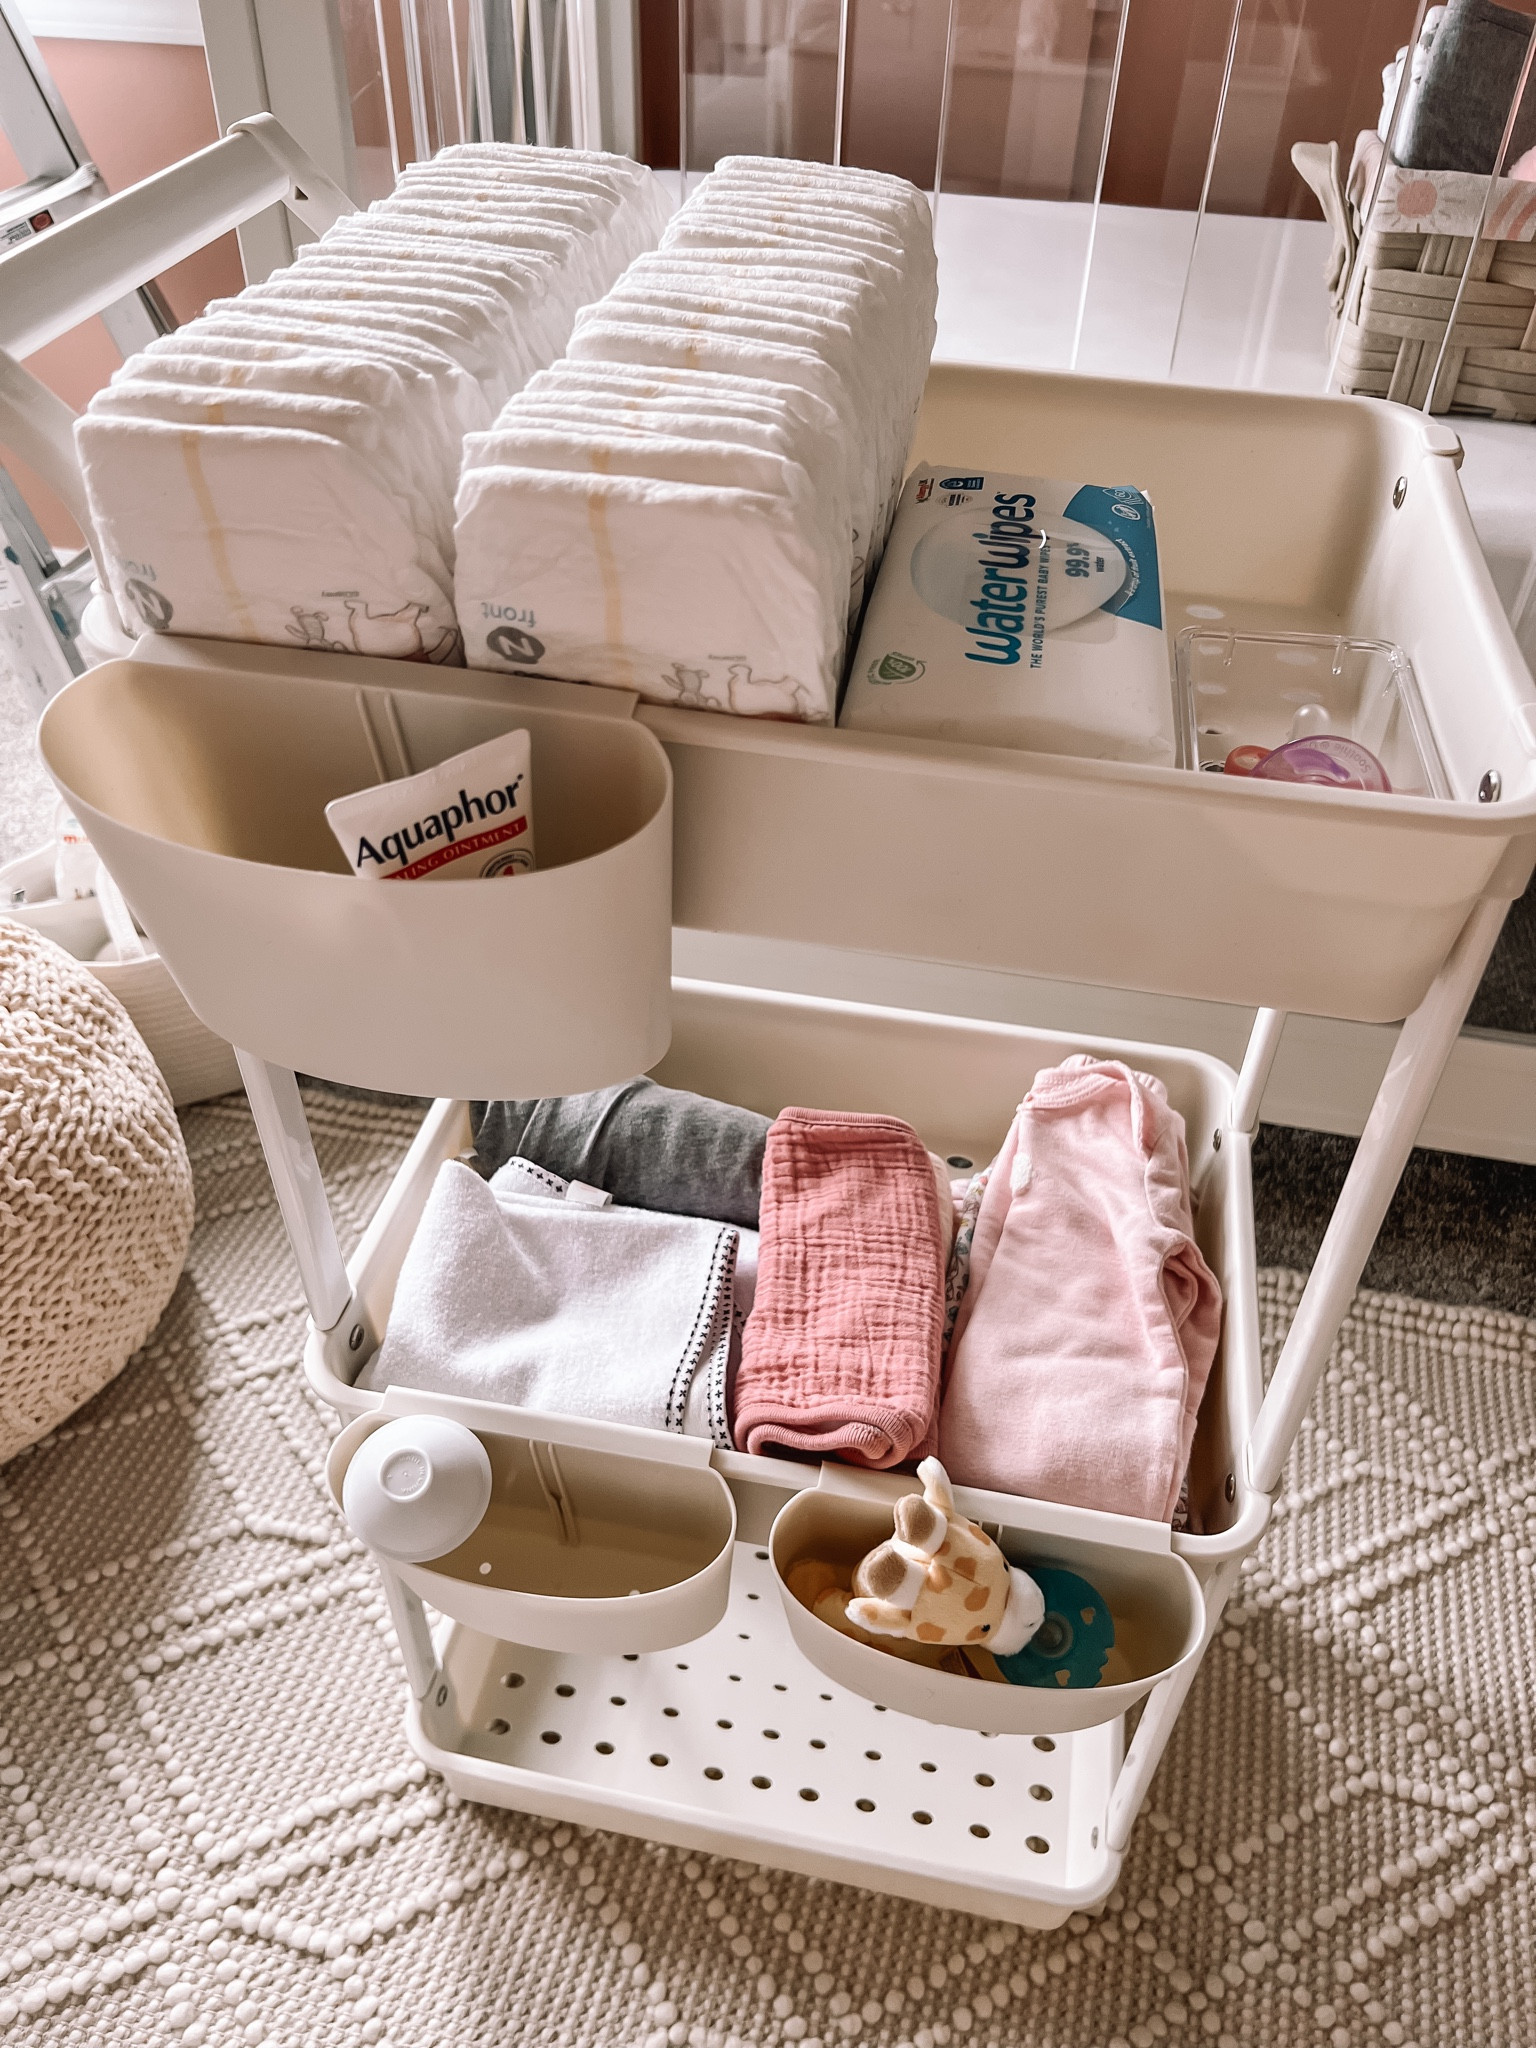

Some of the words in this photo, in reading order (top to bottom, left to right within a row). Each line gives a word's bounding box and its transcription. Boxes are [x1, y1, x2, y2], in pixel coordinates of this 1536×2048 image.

[1040, 544, 1051, 563] WIPES
[1094, 556, 1105, 572] water
[965, 493, 1050, 665] WaterWipes
[1038, 565, 1049, 584] BABY
[1035, 586, 1048, 614] PUREST
[481, 602, 536, 628] front
[1032, 616, 1046, 652] WORLD'S
[1030, 654, 1043, 669] THE
[356, 780, 520, 868] Aquaphor
[443, 823, 520, 861] OINTMENT
